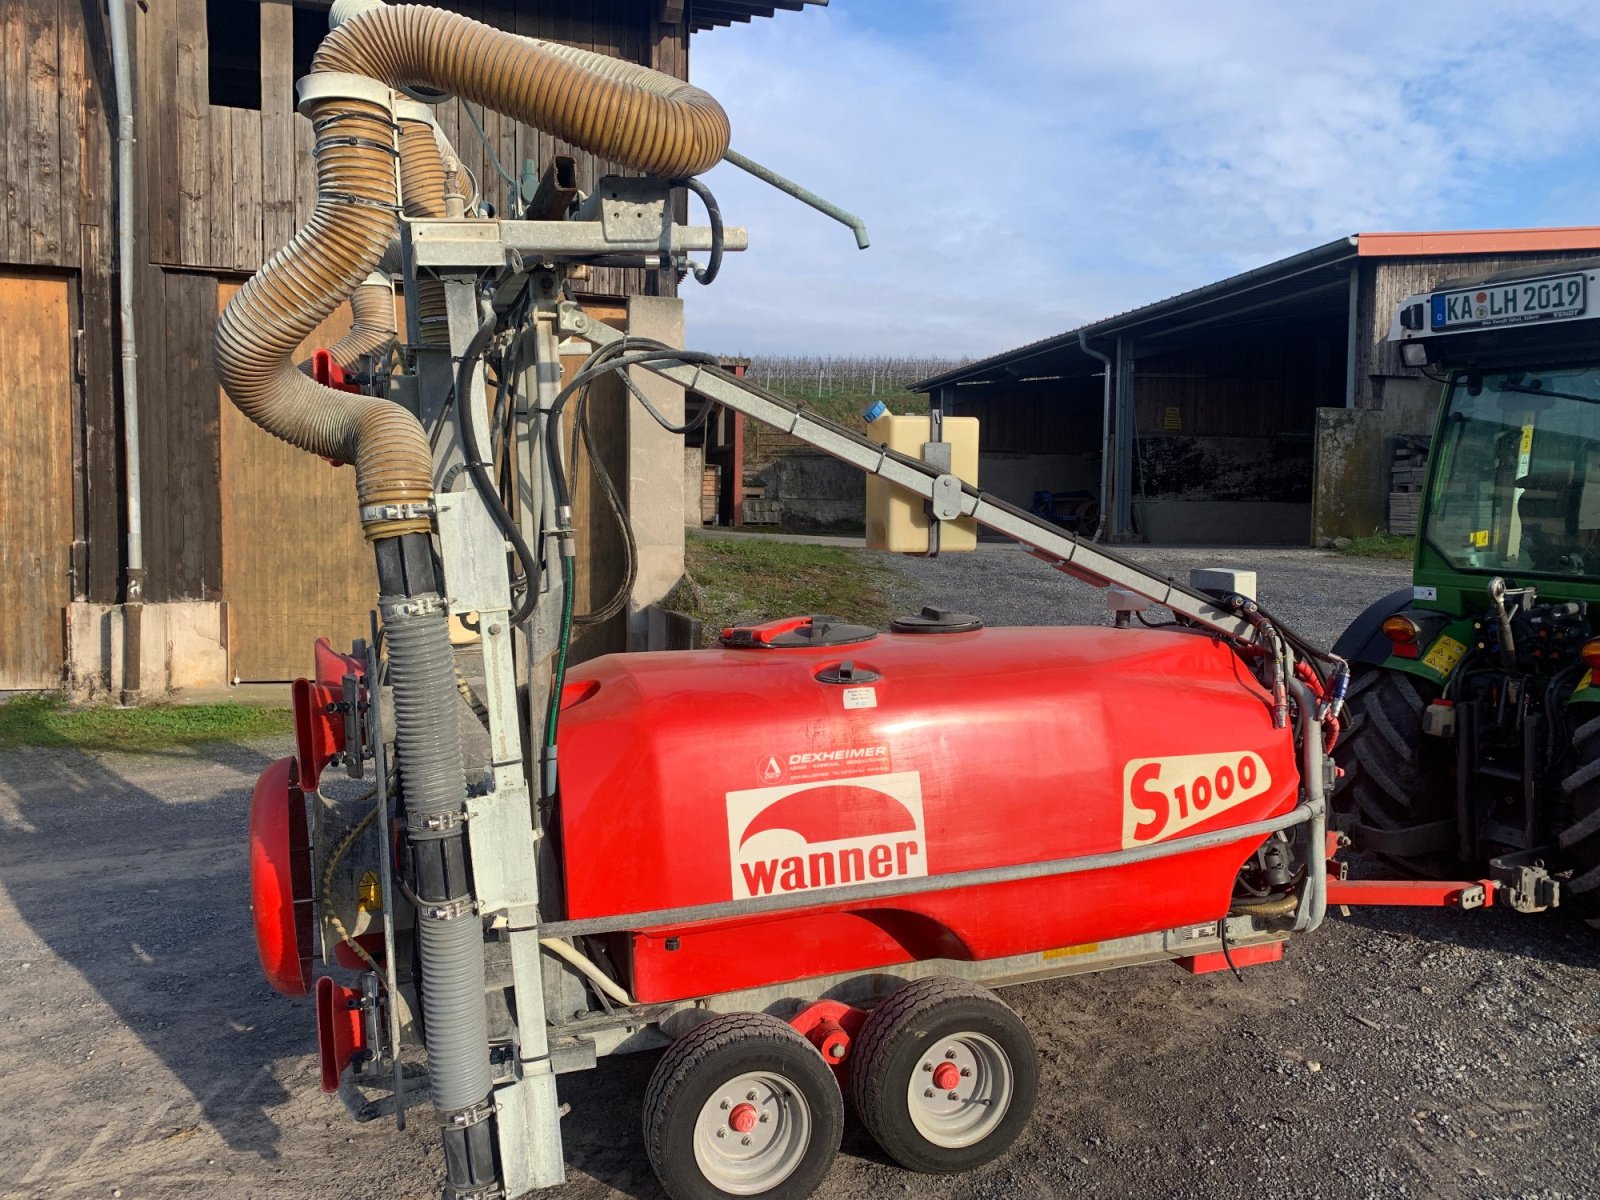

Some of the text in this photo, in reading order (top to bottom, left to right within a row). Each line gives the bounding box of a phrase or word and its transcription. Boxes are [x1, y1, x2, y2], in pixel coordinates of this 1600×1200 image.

[1437, 313, 1443, 321] D
[1447, 280, 1581, 321] KA LH 2019
[788, 745, 888, 765] DEXHEIMER
[1130, 755, 1257, 841] S1000
[740, 839, 919, 897] wanner
